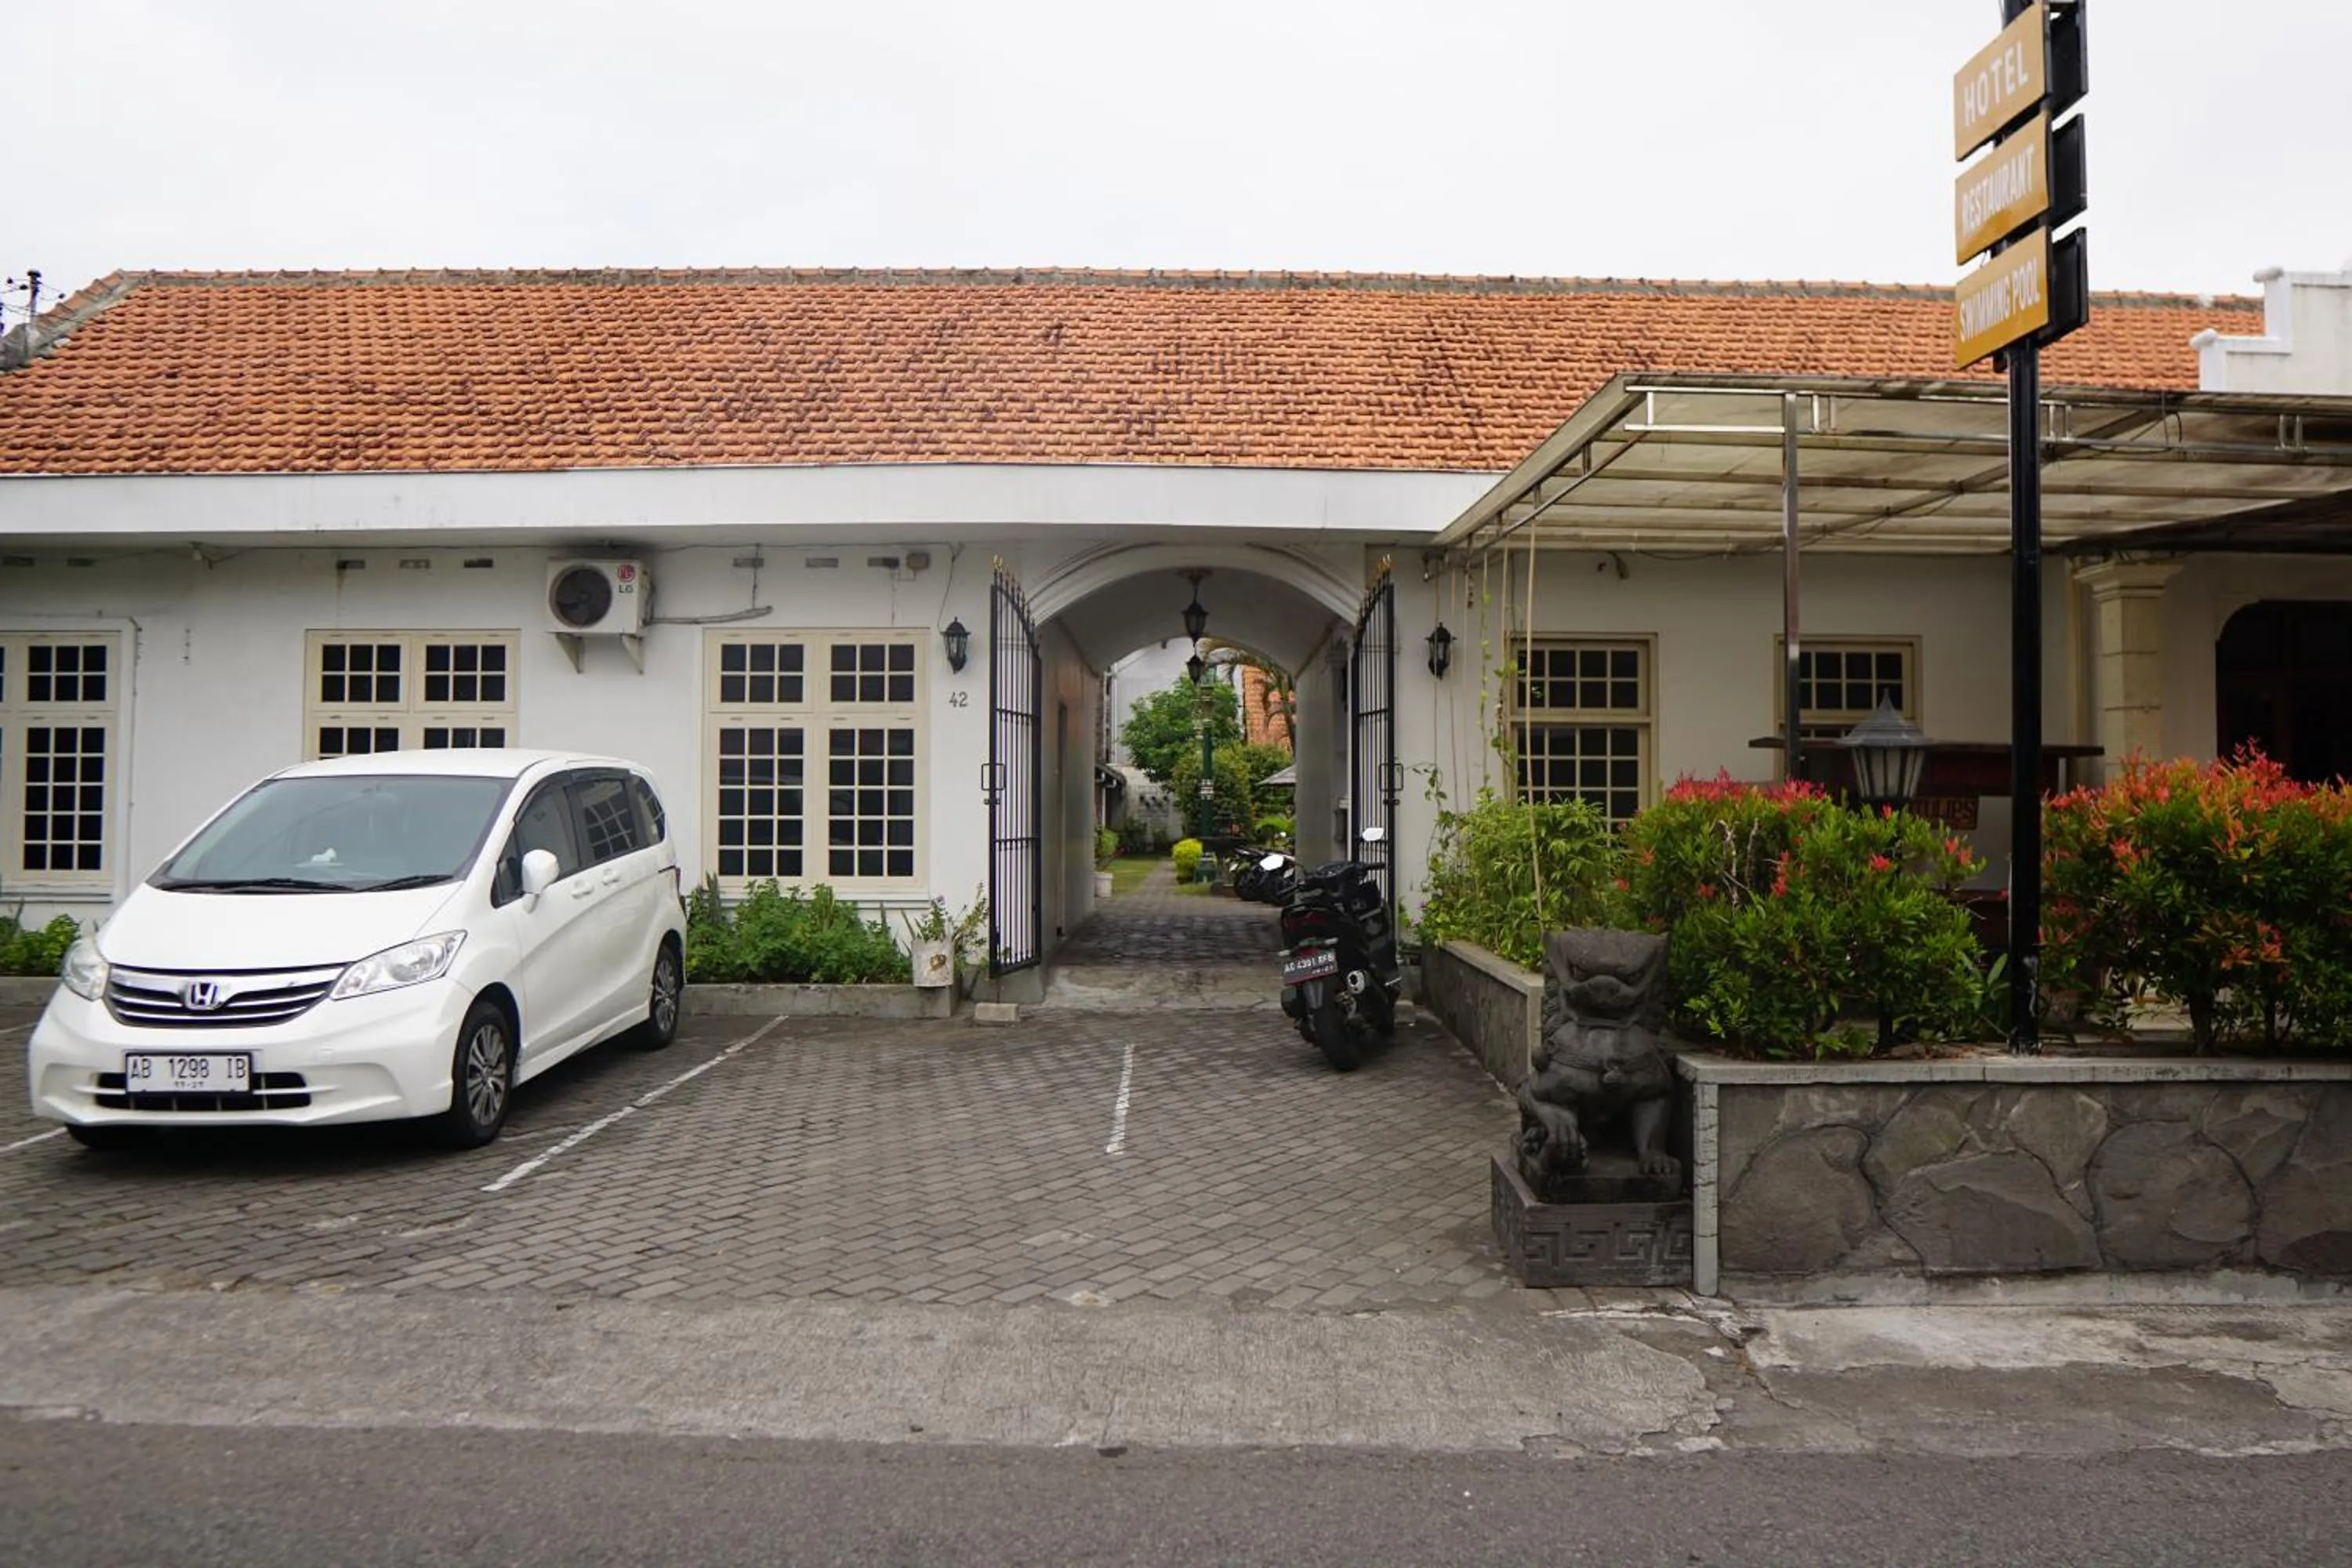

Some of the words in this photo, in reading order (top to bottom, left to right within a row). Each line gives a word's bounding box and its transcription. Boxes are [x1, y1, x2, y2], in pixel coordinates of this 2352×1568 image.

[1964, 40, 2029, 127] HOTEL
[1962, 143, 2034, 234] RESTAURANT
[1959, 274, 2010, 343] SWIMMING
[2012, 256, 2041, 315] POOL
[618, 584, 633, 593] LG
[949, 691, 968, 708] 42
[130, 1058, 152, 1080] AB
[169, 1058, 210, 1079] 1298
[226, 1058, 246, 1079] IB
